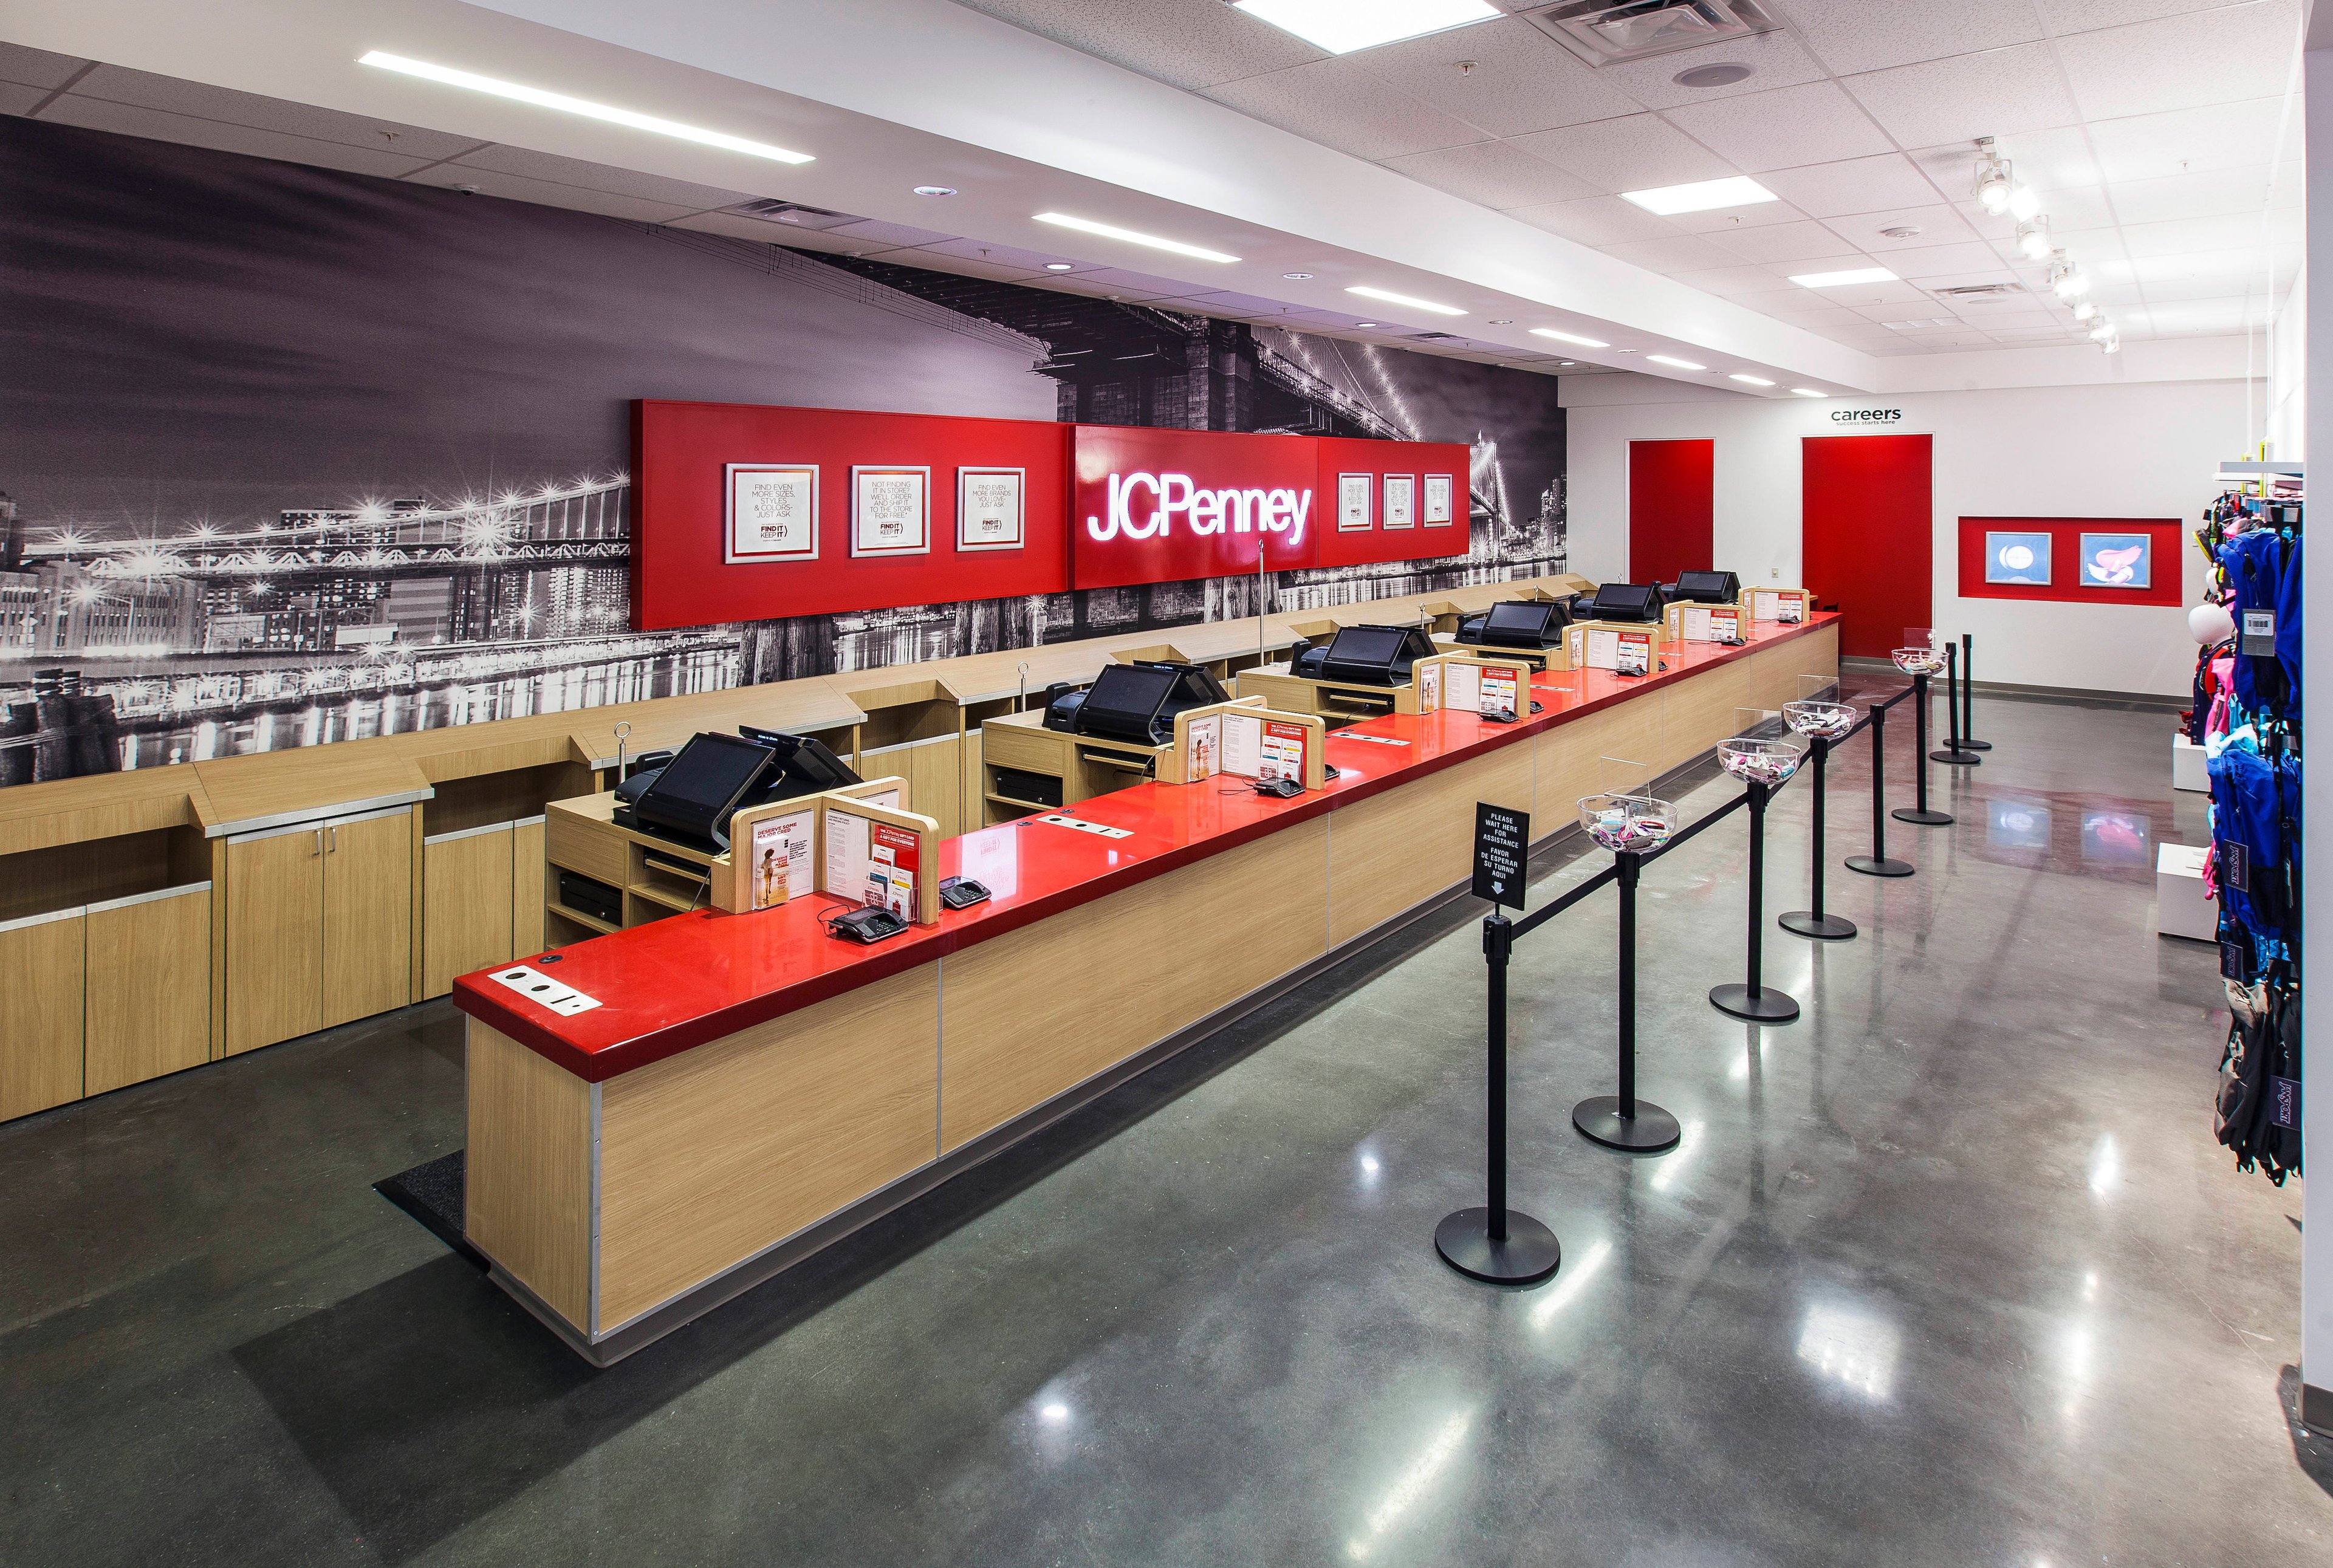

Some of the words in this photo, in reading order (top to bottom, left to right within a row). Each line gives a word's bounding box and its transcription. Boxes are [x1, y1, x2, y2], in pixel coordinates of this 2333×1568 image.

[1831, 409, 1901, 420] careers
[1087, 471, 1312, 546] JCPenney
[1491, 813, 1513, 824] PLEASE
[758, 826, 782, 835] DESERVE
[1485, 819, 1500, 828] WAIT
[1502, 824, 1518, 833] HERE
[1483, 834, 1519, 848] ASSISTANCE
[1491, 847, 1509, 858] FAVOR
[1491, 855, 1518, 868] ESPERAR
[2229, 845, 2239, 884] JANSPORT
[1492, 870, 1506, 879] AQUI
[1495, 863, 1514, 874] TURNO
[2278, 1081, 2292, 1124] JANSPORT
